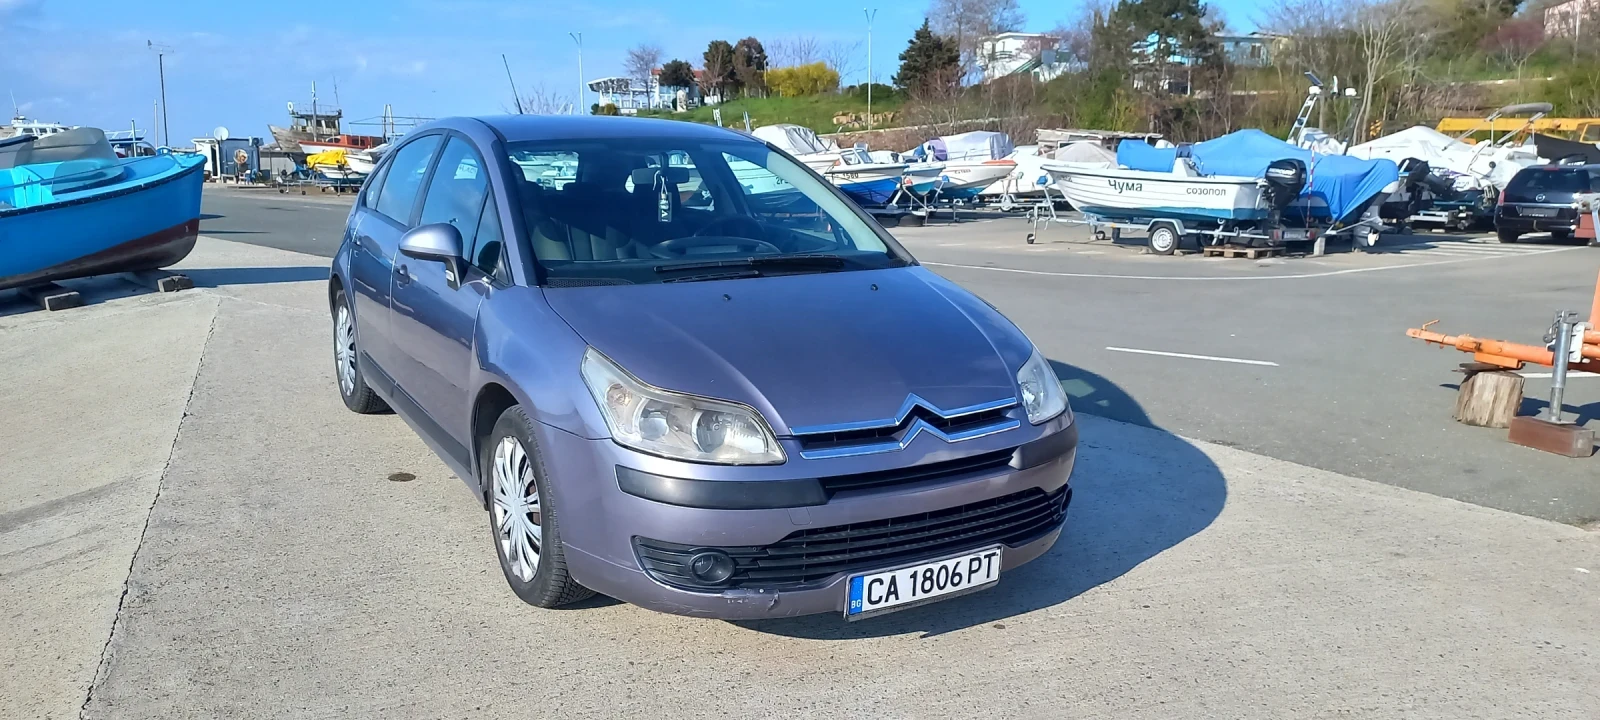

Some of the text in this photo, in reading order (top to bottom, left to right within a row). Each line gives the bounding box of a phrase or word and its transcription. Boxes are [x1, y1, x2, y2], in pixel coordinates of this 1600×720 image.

[1108, 179, 1143, 194] Чума
[867, 551, 999, 606] CA 1806 PT
[850, 599, 862, 609] BG
